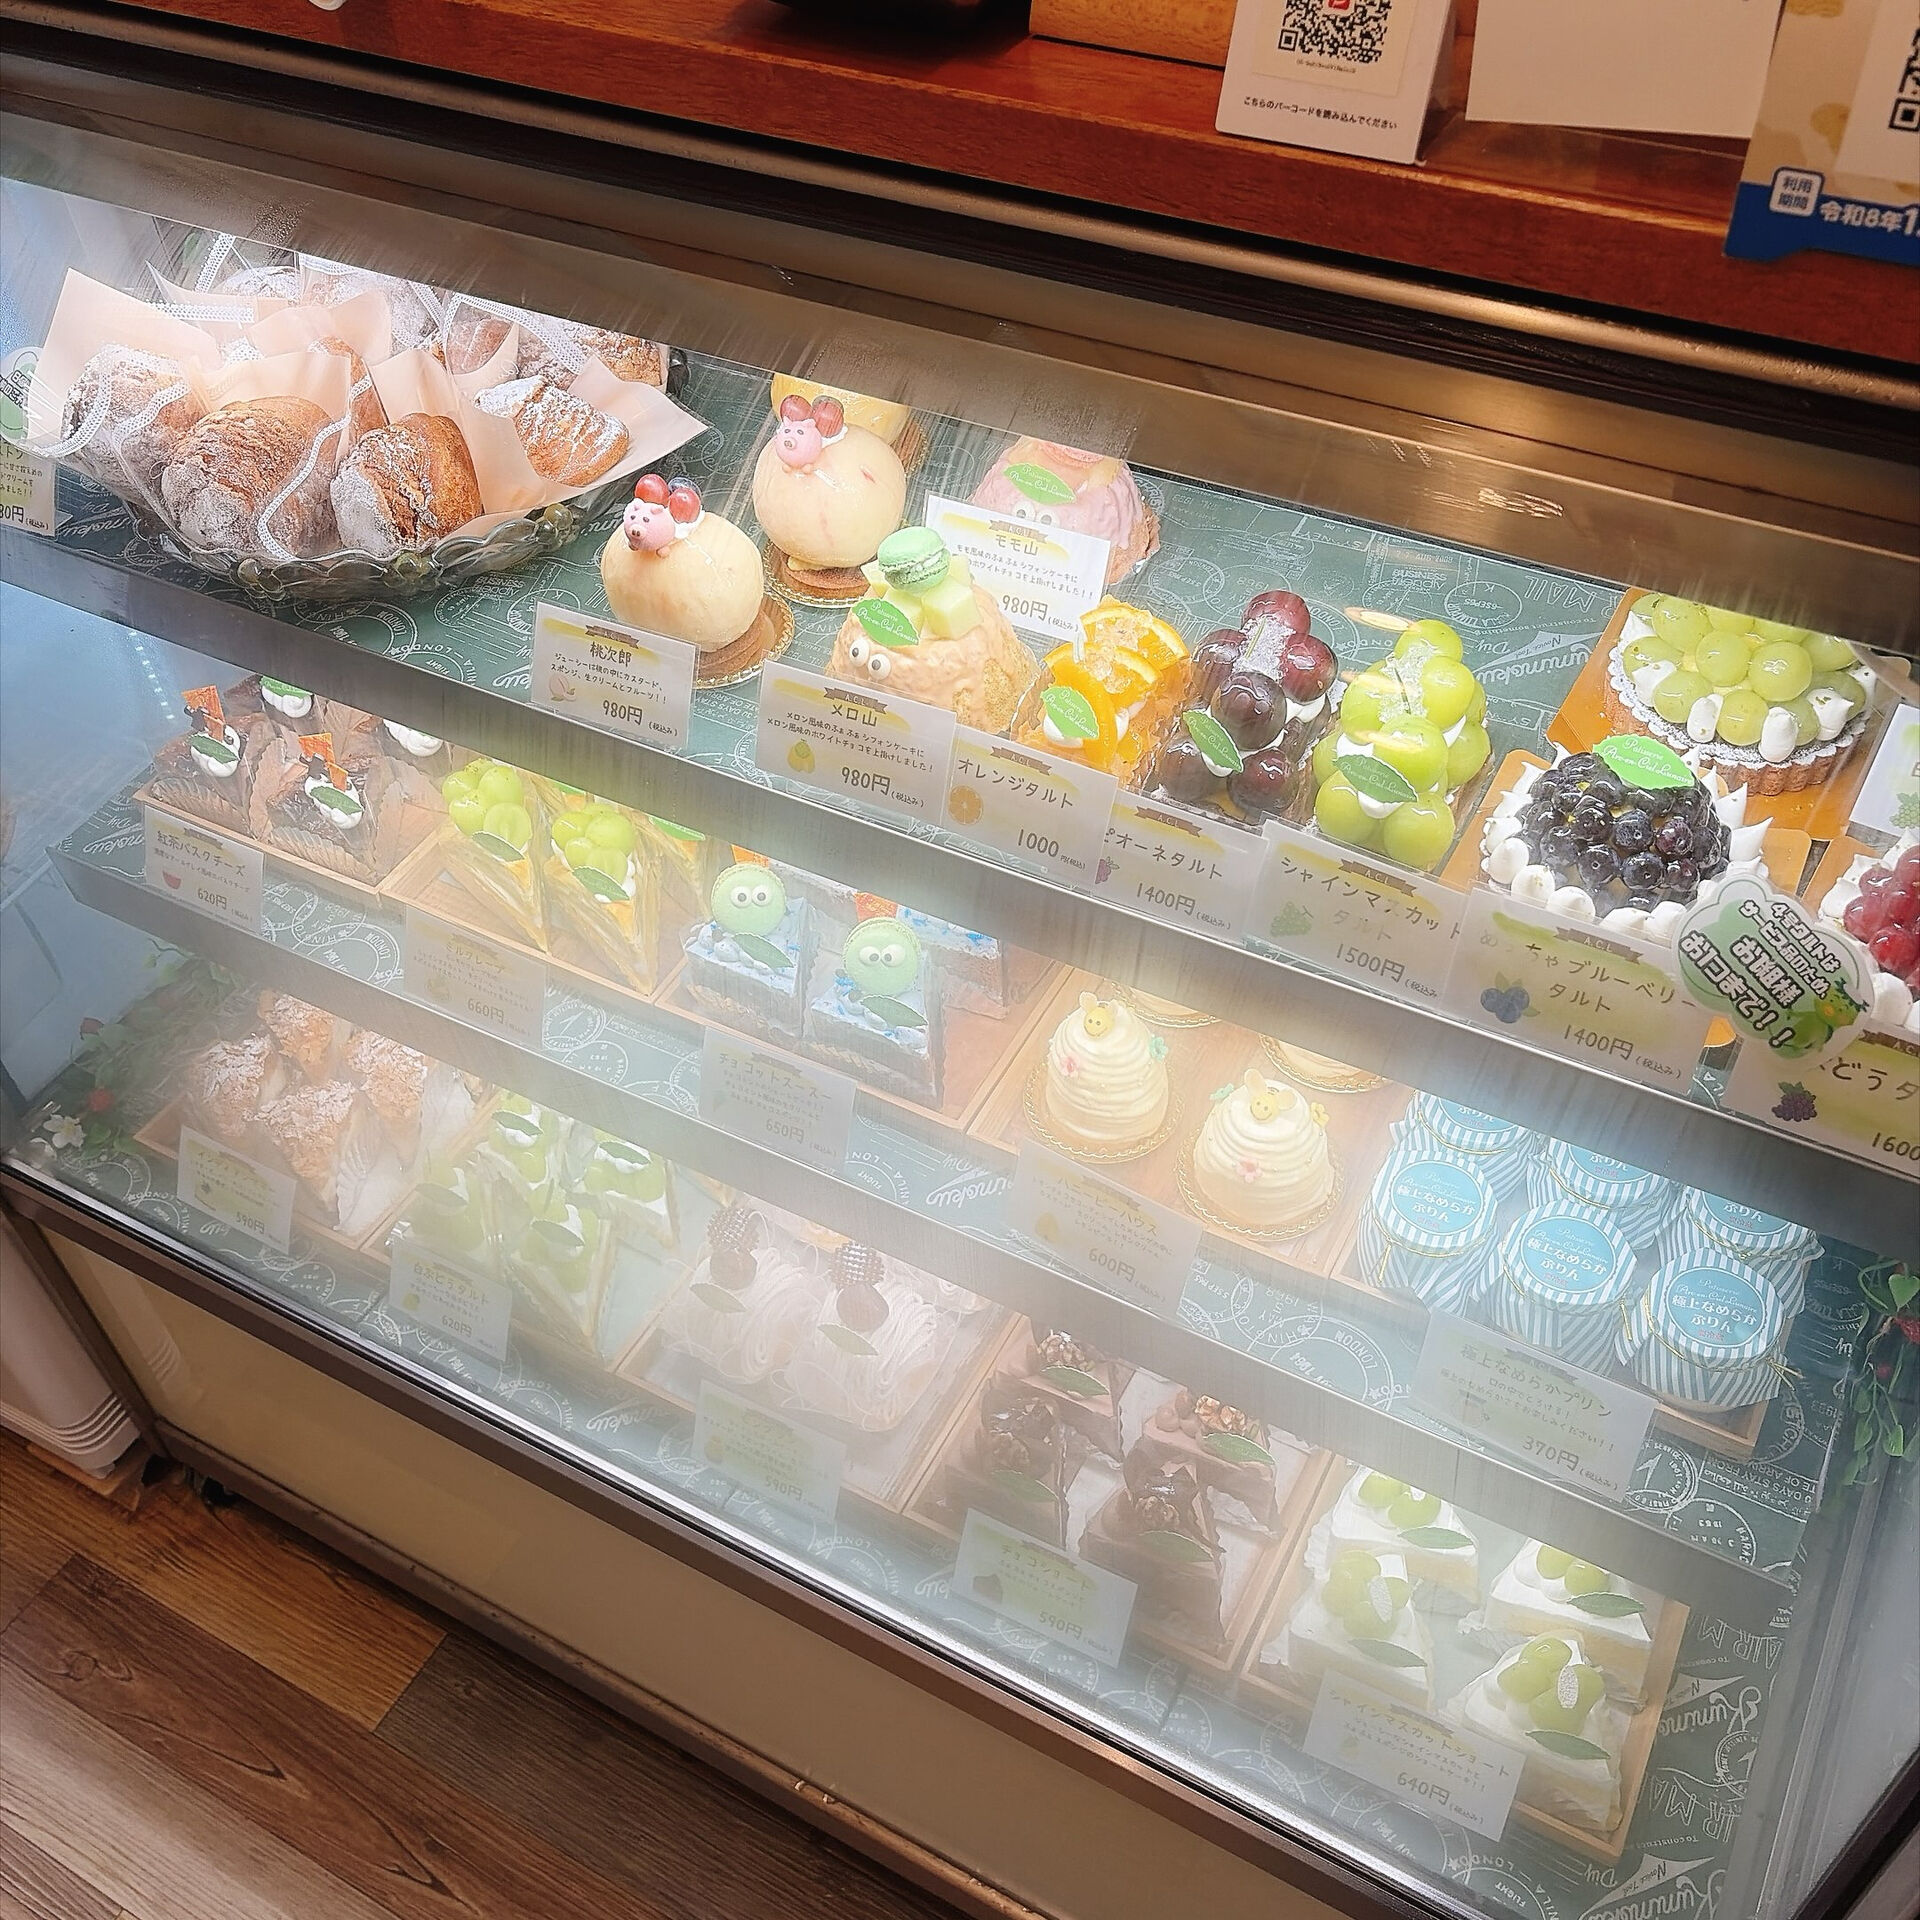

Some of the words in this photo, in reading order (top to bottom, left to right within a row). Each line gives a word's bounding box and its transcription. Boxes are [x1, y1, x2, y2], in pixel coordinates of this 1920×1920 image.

[1244, 96, 1398, 130] こちらのバーコードを読み込んでください
[995, 534, 1039, 556] モモ山
[1523, 575, 1597, 613] MAIL
[1002, 594, 1048, 621] 980円
[1048, 616, 1078, 632] (税込み)
[590, 641, 632, 667] 桃次郎
[602, 700, 643, 726] 980円
[648, 721, 678, 737] (税込み)
[831, 705, 878, 727] メロ山
[841, 767, 891, 796] 980円
[890, 790, 924, 807] (税込み)
[957, 758, 1074, 809] オレンジタルト
[157, 830, 246, 877] 紅茶バスクチーズ
[1017, 829, 1060, 858] 1000
[197, 887, 227, 910] 620円
[1137, 882, 1196, 916] 1400円
[1196, 911, 1231, 930] (税込み)
[1280, 856, 1460, 940] シャインマスカット
[1738, 899, 1831, 999] サービス品のため、
[1770, 901, 1842, 974] 4号タルトは
[1337, 943, 1405, 983] 1500円
[467, 997, 505, 1025] 660円
[1550, 983, 1611, 1013] タルト
[1563, 1024, 1634, 1060] 1400円
[1635, 1055, 1681, 1079] (税込み)
[719, 1053, 832, 1100] チョコットスースー
[766, 1118, 805, 1144] 650円
[1397, 1185, 1476, 1216] 極上なめらか
[1088, 1247, 1136, 1283] 600円
[1527, 1237, 1607, 1275] 極上なめらか
[441, 1315, 473, 1339] 620円
[1671, 1294, 1757, 1326] 極上なめらか
[1334, 1330, 1377, 1369] LONDON
[1460, 1343, 1612, 1418] 極上なめらかプリン
[1521, 1435, 1580, 1473] 370円
[1579, 1466, 1619, 1491] (税込み)
[765, 1474, 803, 1501] 590円
[1039, 1611, 1082, 1641] 590円
[1328, 1688, 1512, 1778] シャインマスカットショート
[1397, 1771, 1450, 1806] 640円
[1495, 1881, 1526, 1908] FLIGHT
